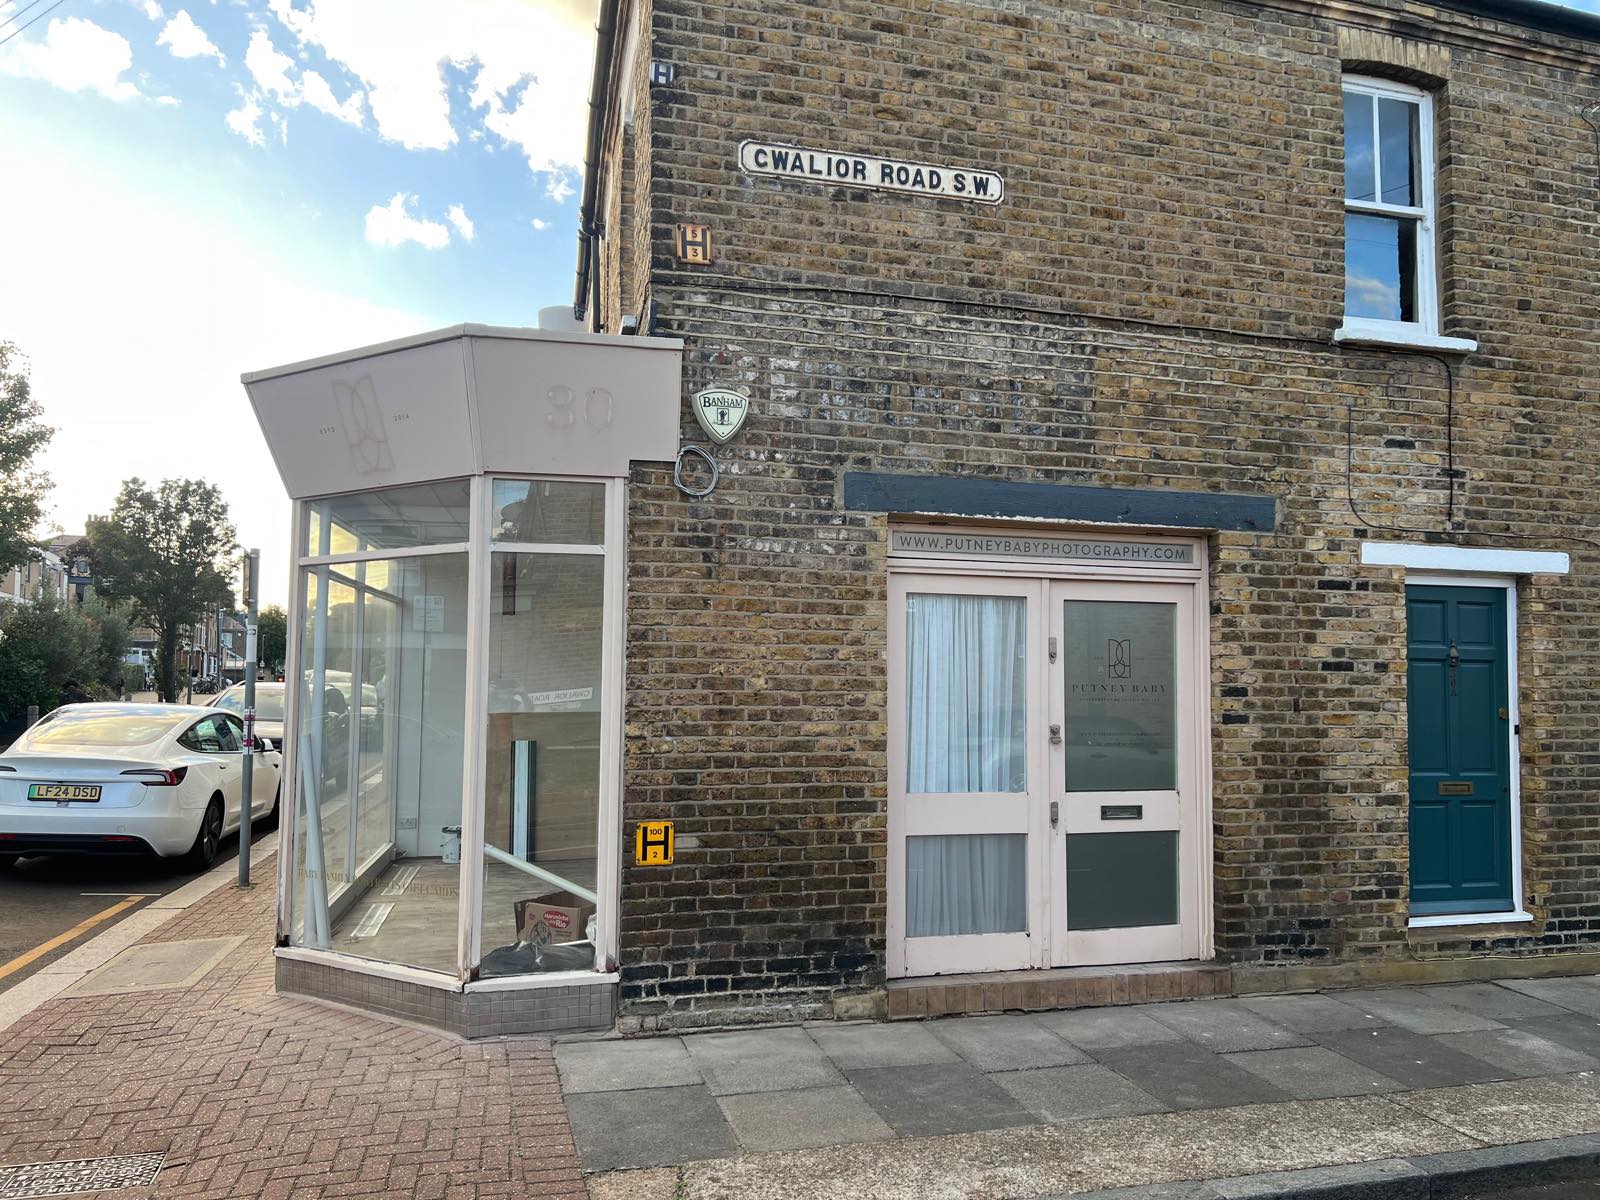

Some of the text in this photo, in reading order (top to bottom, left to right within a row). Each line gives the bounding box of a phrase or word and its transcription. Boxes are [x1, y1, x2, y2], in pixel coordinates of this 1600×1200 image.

[691, 230, 698, 239] 5
[681, 227, 707, 260] H
[691, 248, 698, 257] 3
[900, 535, 1185, 559] WWW.PUTNEYBABYPHOTOGRAPHY.COM
[1073, 684, 1167, 693] PUTNEY BABY
[37, 786, 98, 798] LF24 DSD
[642, 826, 669, 861] H
[652, 851, 658, 859] 2
[32, 1170, 76, 1180] FIRE
[6, 1175, 91, 1189] HYDRANT
